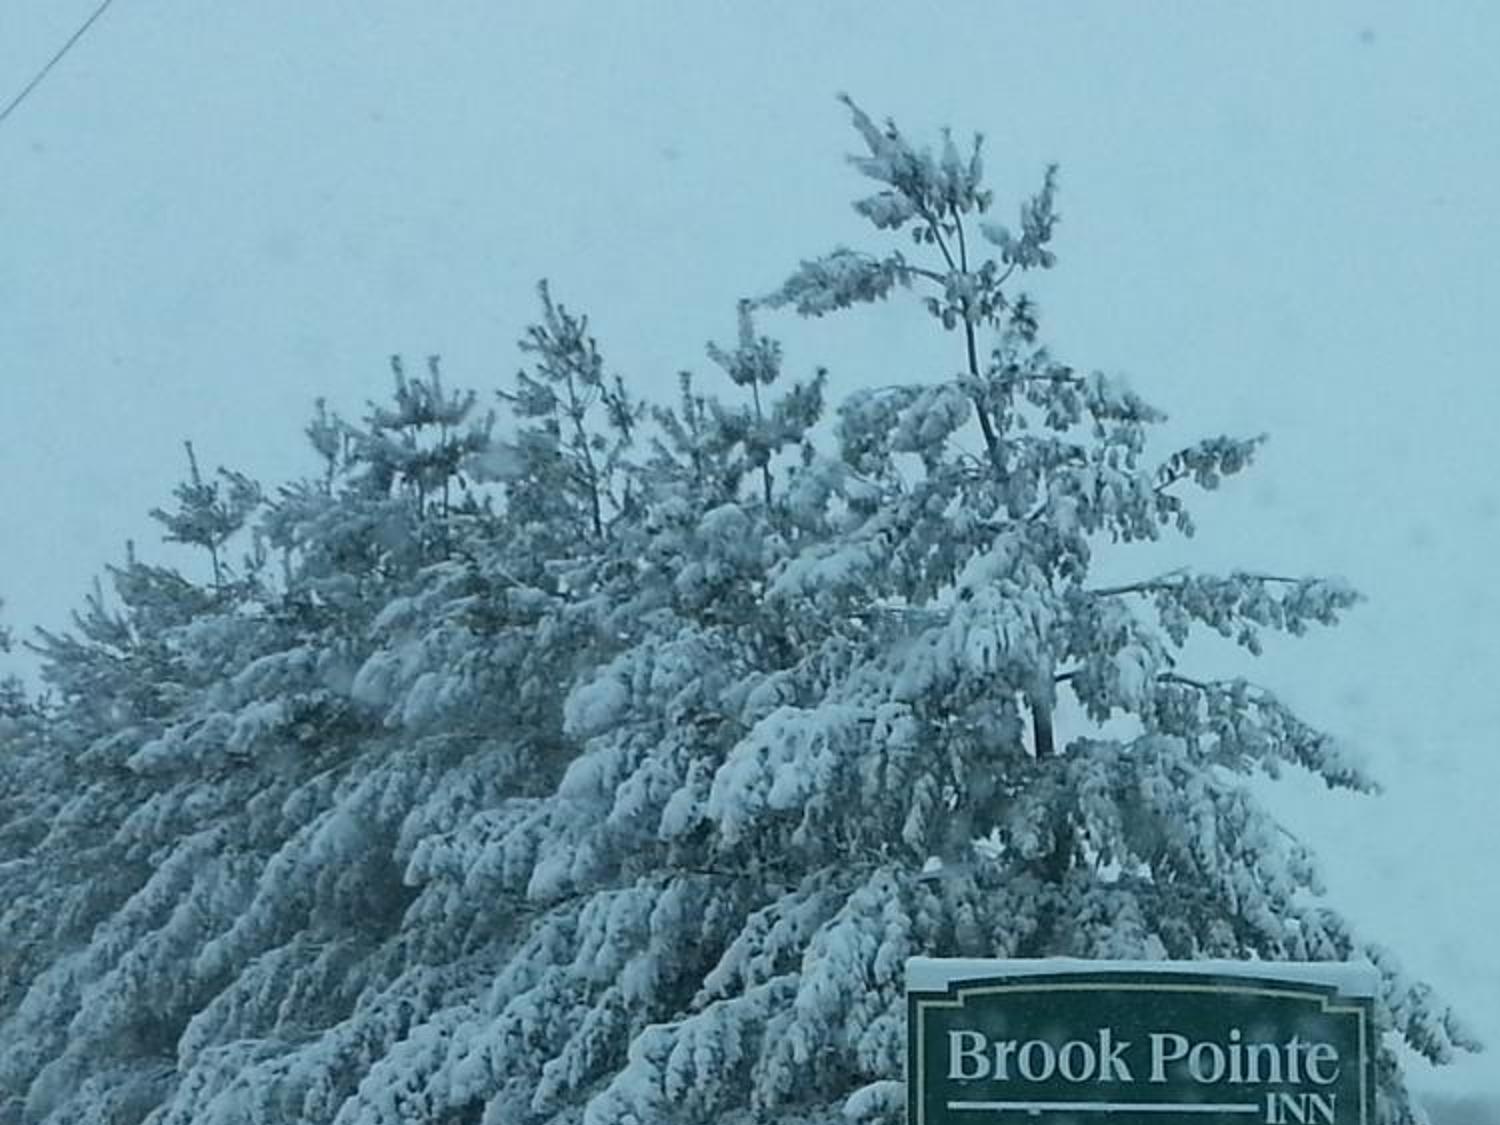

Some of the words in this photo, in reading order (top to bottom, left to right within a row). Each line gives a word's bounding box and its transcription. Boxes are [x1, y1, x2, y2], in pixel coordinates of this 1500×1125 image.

[947, 1028, 1134, 1082] Brook
[1149, 1029, 1340, 1085] Pointe
[1265, 1093, 1336, 1125] INN
